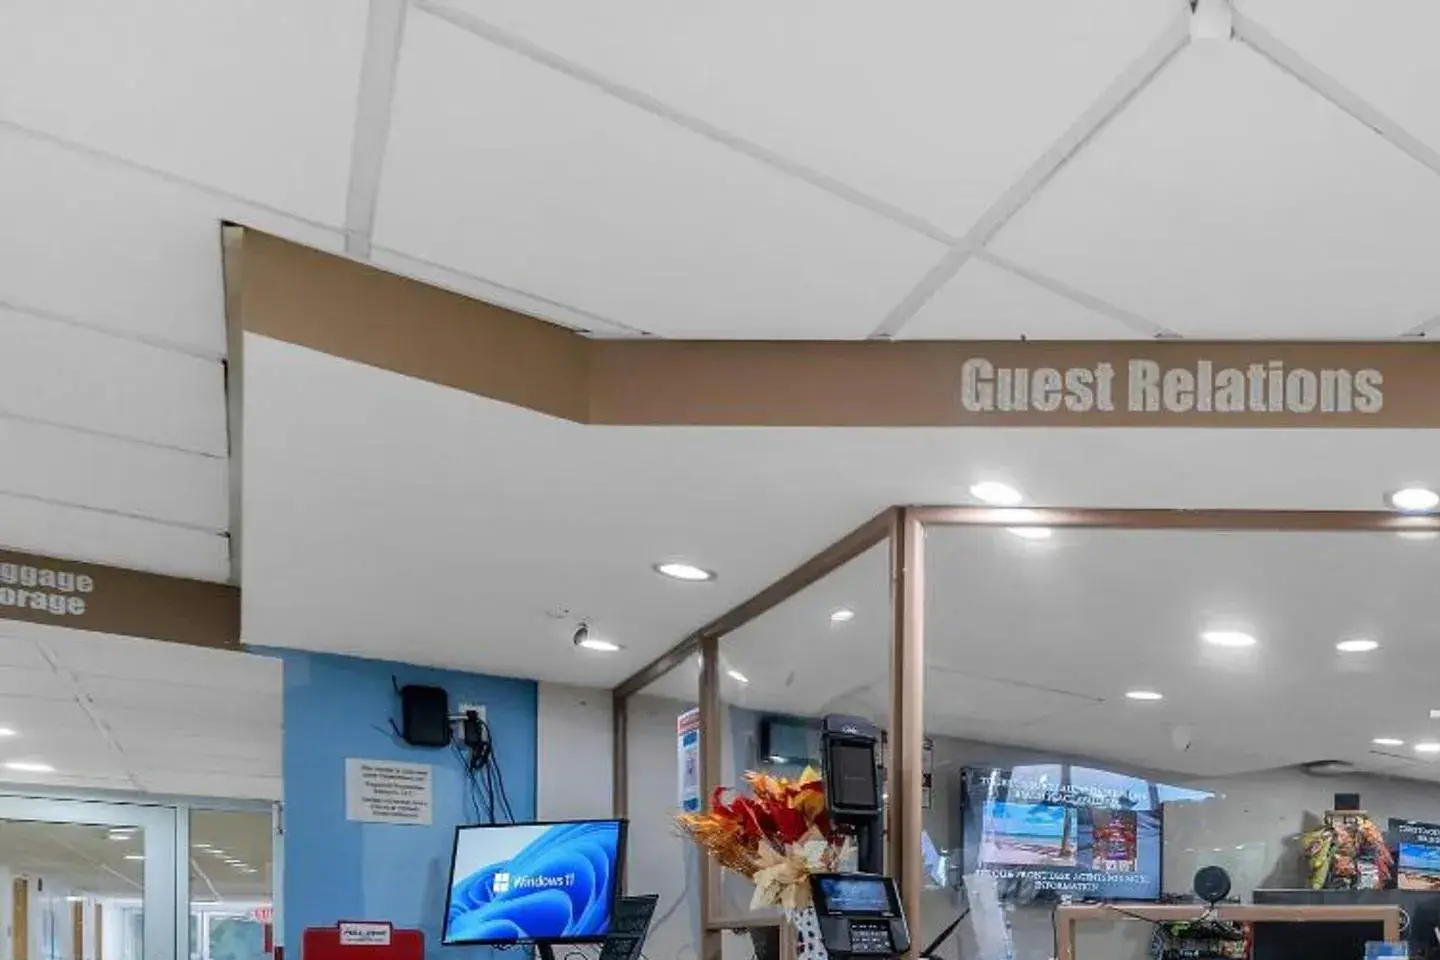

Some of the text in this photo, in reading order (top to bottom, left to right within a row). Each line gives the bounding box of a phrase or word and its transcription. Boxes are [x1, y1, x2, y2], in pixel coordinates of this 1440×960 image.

[961, 357, 1384, 414] Guest Relations
[514, 874, 563, 888] Windows
